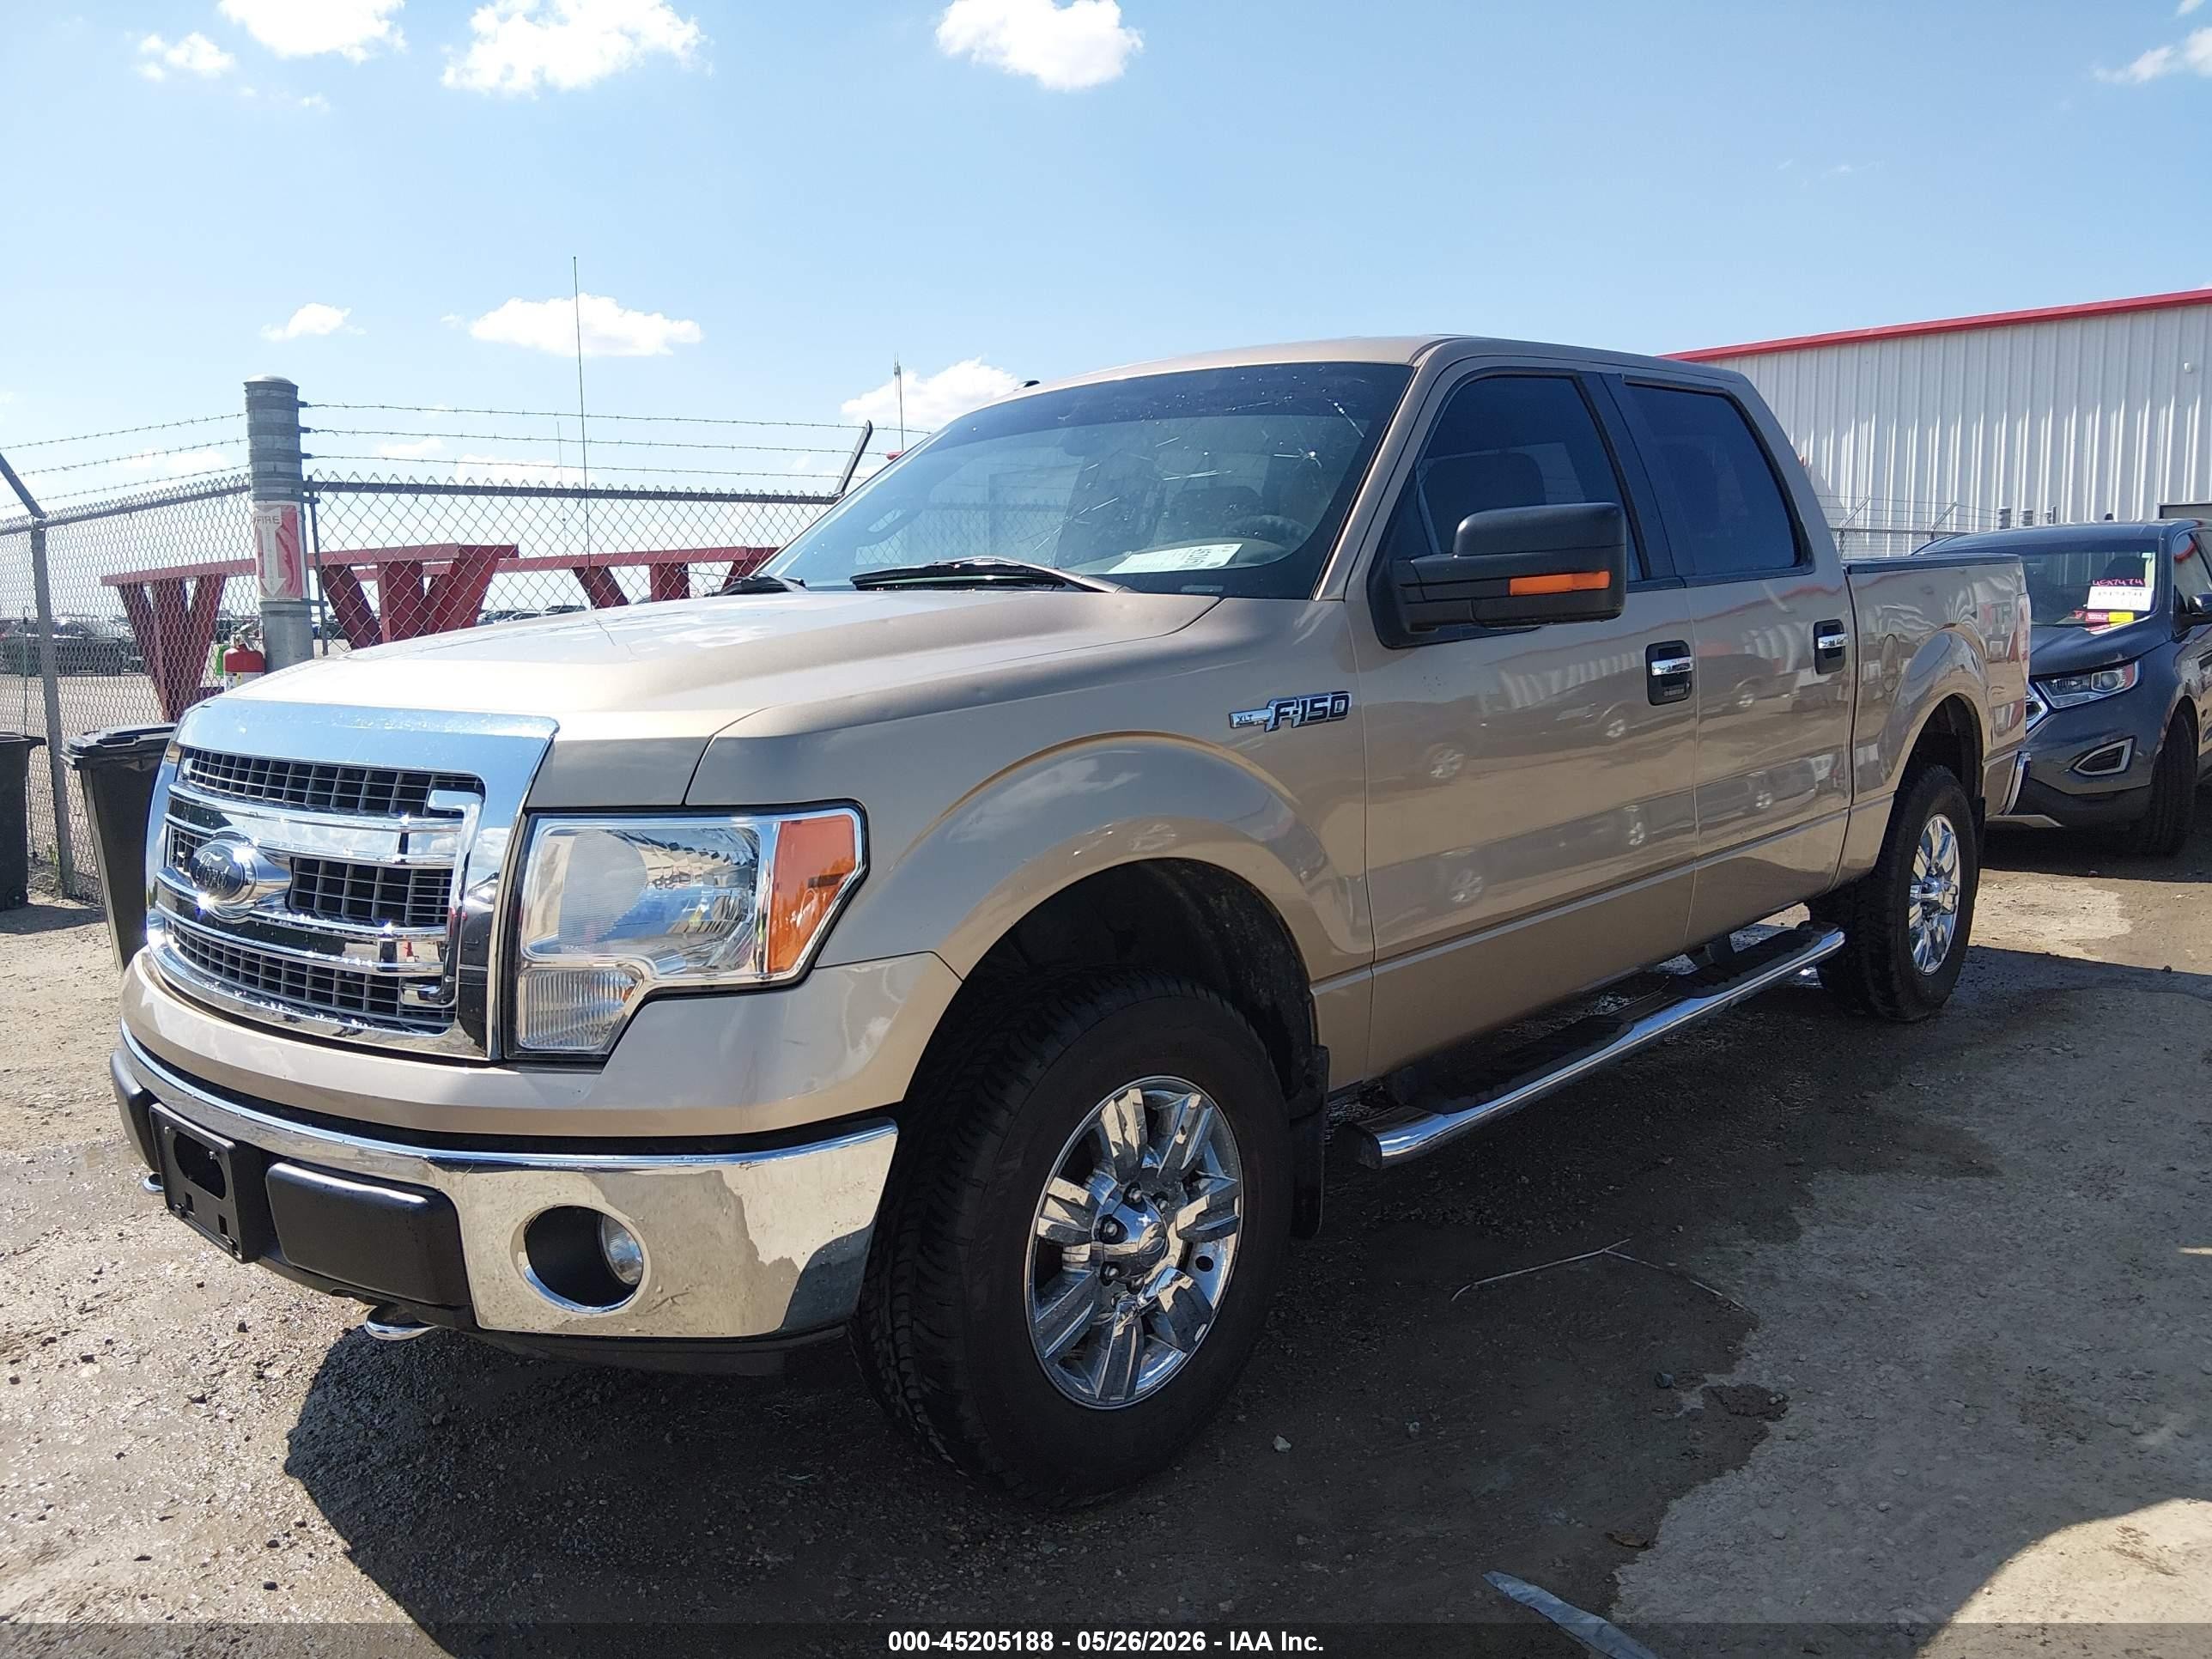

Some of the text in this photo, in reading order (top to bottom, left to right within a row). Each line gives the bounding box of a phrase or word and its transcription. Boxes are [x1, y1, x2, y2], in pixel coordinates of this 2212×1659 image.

[255, 515, 281, 525] FIRE
[1237, 714, 1254, 723] XLT
[196, 851, 231, 890] Ford
